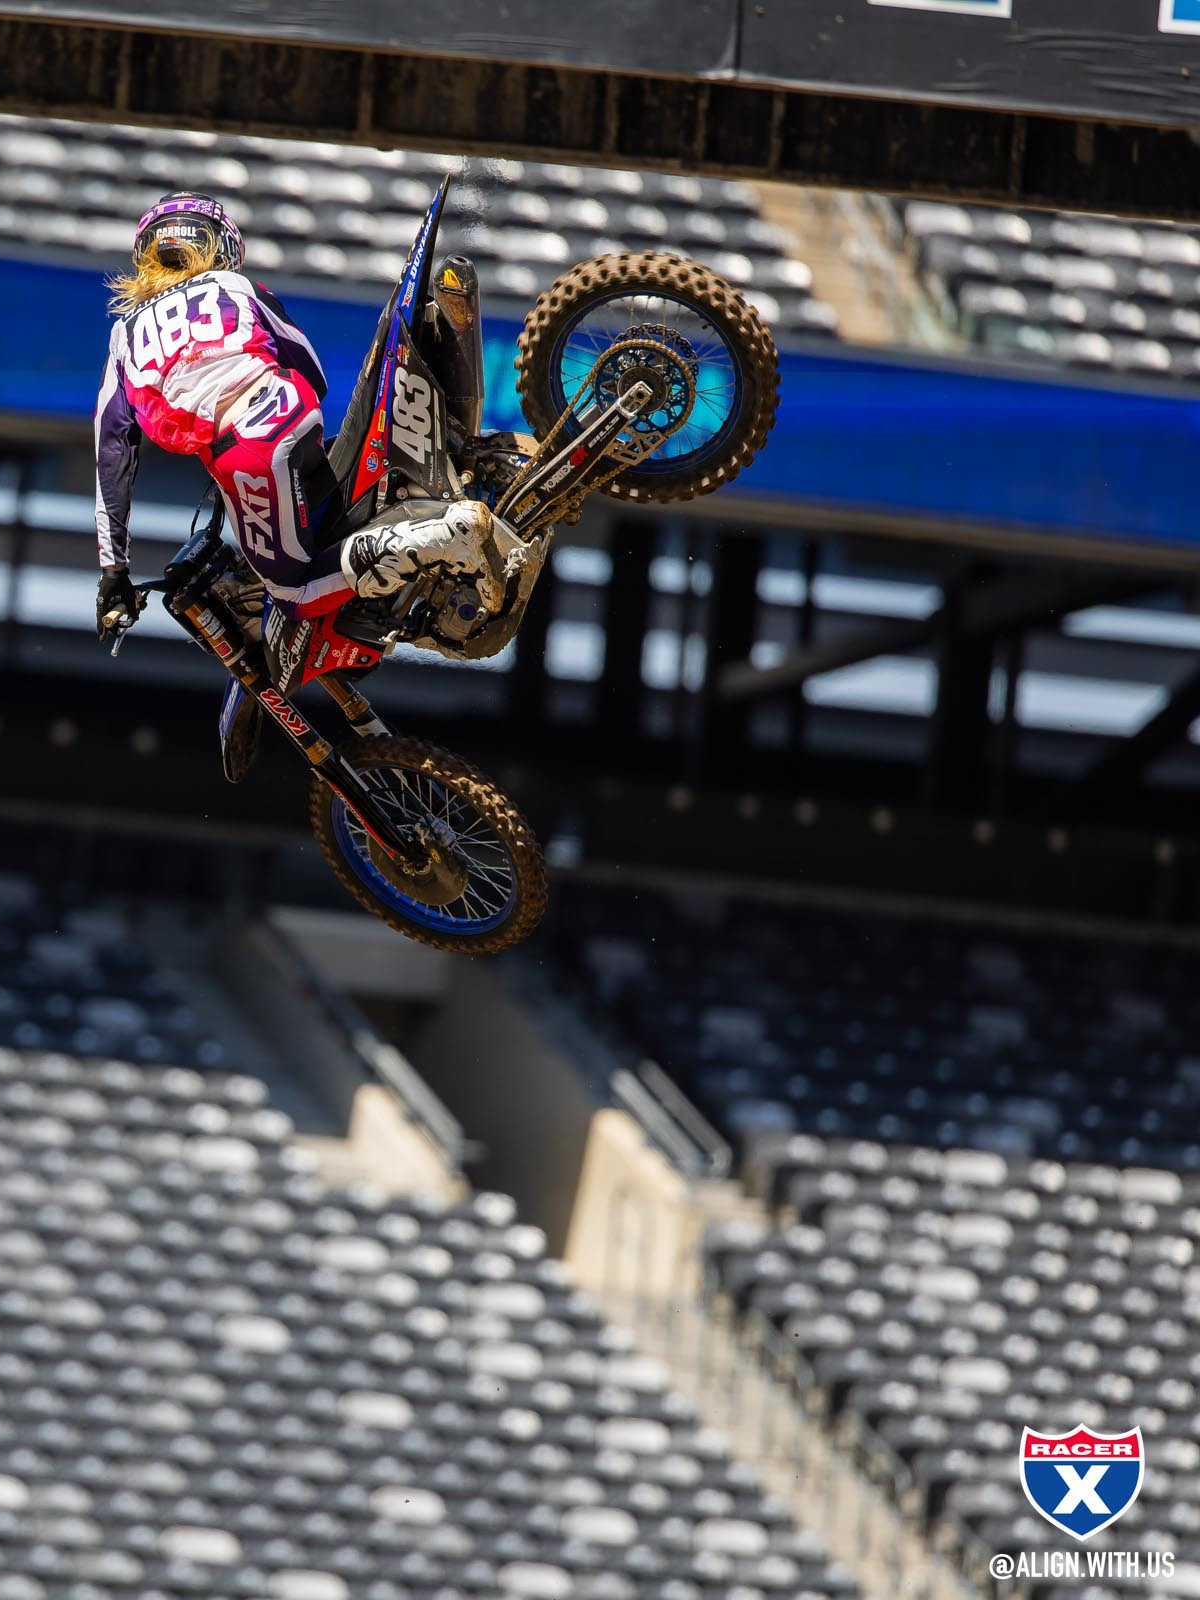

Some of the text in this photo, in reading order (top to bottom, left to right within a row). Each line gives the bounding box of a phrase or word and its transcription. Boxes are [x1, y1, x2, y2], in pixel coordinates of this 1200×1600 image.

[156, 225, 198, 239] CARROLL
[410, 213, 432, 279] DUNLOP
[132, 281, 224, 370] 483
[392, 367, 432, 465] 483
[539, 461, 576, 493] VORTEX
[233, 470, 275, 561] FXR
[513, 498, 541, 525] WHEELS
[514, 490, 537, 514] KSR
[291, 619, 311, 656] BALLS
[259, 688, 310, 736] KYB
